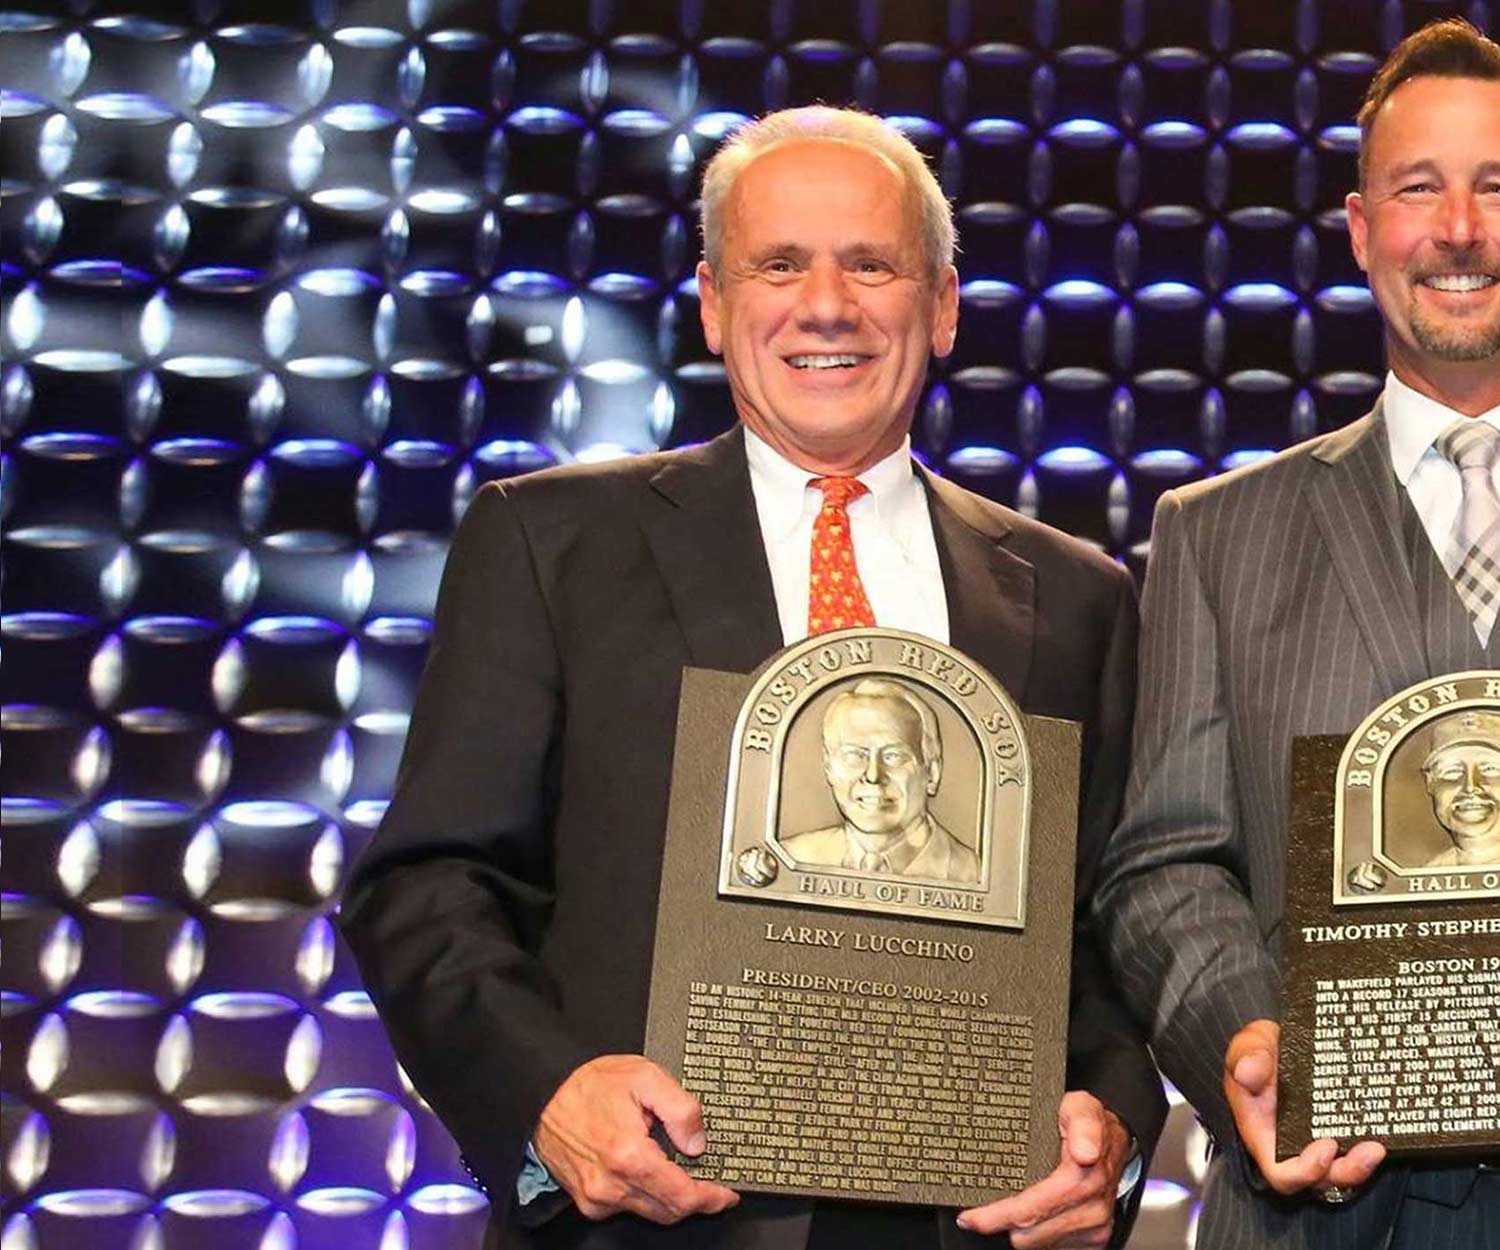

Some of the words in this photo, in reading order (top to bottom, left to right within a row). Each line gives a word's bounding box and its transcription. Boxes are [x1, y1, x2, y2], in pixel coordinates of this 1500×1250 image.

[746, 640, 872, 754] BOSTON
[898, 641, 980, 696] RED
[983, 712, 1023, 788] SOX
[1347, 681, 1460, 789] BOSTON
[1407, 873, 1472, 892] HALL
[799, 874, 865, 899] HALL
[875, 884, 909, 903] OF
[918, 890, 985, 912] FAME
[1301, 923, 1407, 942] TIMOTHY
[766, 923, 845, 948] LARRY
[853, 934, 974, 962] LUCCHINO
[1398, 958, 1475, 974] BOSTON
[742, 968, 897, 997] PRESIDENT/CEO
[902, 984, 988, 1006] 2002-2015
[1316, 980, 1334, 990] TIM
[1337, 977, 1391, 989] WAKEFIELD
[1395, 975, 1442, 986] PARLAYED
[1447, 974, 1463, 983] HIS
[1315, 991, 1339, 1001] INTO
[1352, 989, 1391, 999] RECORD
[1396, 988, 1407, 997] 17
[1412, 986, 1455, 997] SEASONS
[1459, 984, 1484, 994] WITH
[1315, 1002, 1346, 1014] AFTER
[1352, 1001, 1369, 1012] HIS
[1375, 999, 1420, 1011] RELEASE
[1426, 998, 1439, 1008] BY
[1316, 1015, 1337, 1026] 14-1
[1344, 1014, 1355, 1024] IN
[1361, 1013, 1378, 1023] HIS
[1384, 1011, 1412, 1022] FIRST
[1419, 1011, 1430, 1020] 15
[1437, 1008, 1489, 1019] DECISIONS
[1314, 1027, 1344, 1037] START
[1351, 1026, 1362, 1035] TO
[1380, 1024, 1400, 1034] RED
[1407, 1023, 1426, 1033] SOX
[1430, 1021, 1468, 1031] CAREER
[1475, 1020, 1498, 1029] THAT
[1349, 1037, 1379, 1048] THIRD
[1385, 1037, 1396, 1046] IN
[1403, 1035, 1428, 1045] CLUB
[1435, 1033, 1476, 1044] HISTORY
[1313, 1051, 1347, 1062] YOUNG
[1313, 1064, 1348, 1075] SERIES
[1352, 1062, 1385, 1073] TITLES
[1390, 1061, 1400, 1071] IN
[1405, 1060, 1429, 1070] 2004
[1434, 1059, 1454, 1069] AND
[1312, 1076, 1341, 1086] WHEN
[1348, 1075, 1361, 1085] HE
[1367, 1073, 1396, 1084] MADE
[1403, 1072, 1422, 1082] THE
[1428, 1071, 1456, 1081] FINAL
[1463, 1069, 1493, 1079] START
